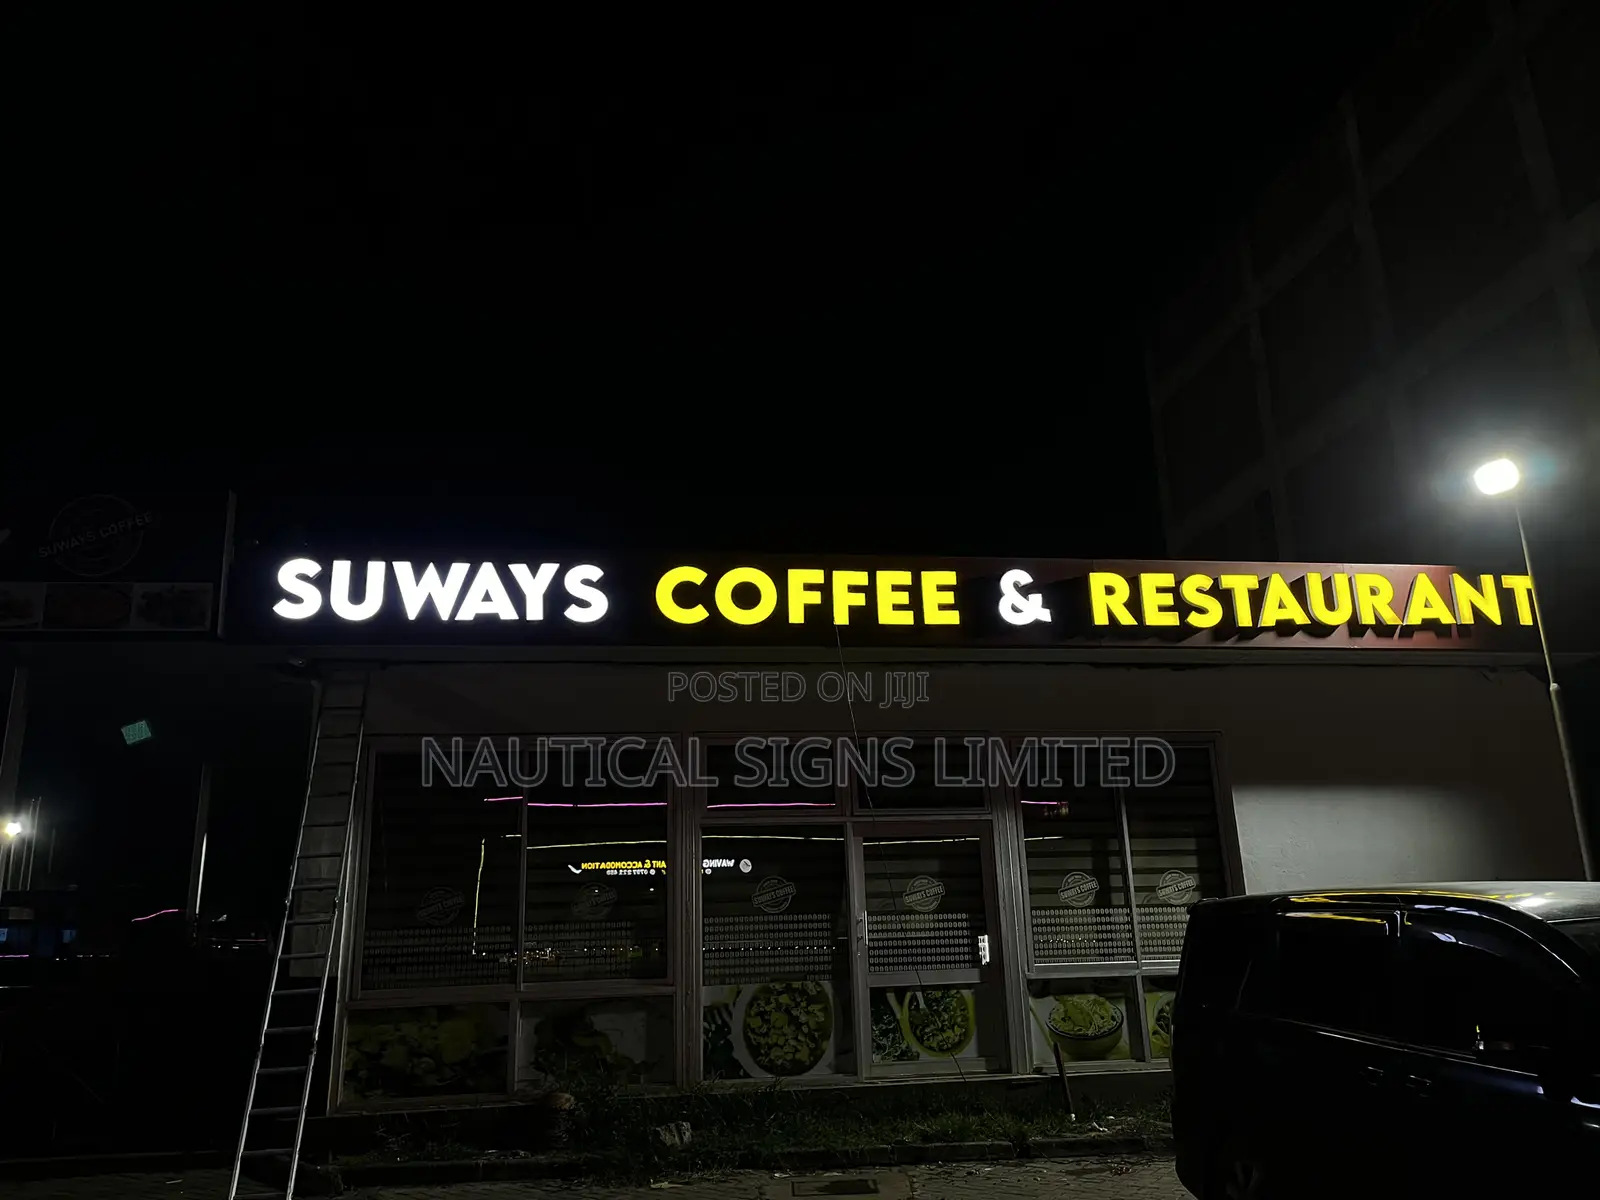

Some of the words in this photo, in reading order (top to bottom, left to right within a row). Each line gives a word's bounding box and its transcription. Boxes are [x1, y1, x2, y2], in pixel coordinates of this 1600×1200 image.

[38, 530, 97, 558] SUWAYS
[99, 510, 154, 538] COFFEE
[272, 557, 609, 623] SUWAYS
[655, 565, 960, 625] COFFEE
[998, 568, 1052, 626] &
[1089, 571, 1535, 628] RESTAURANT
